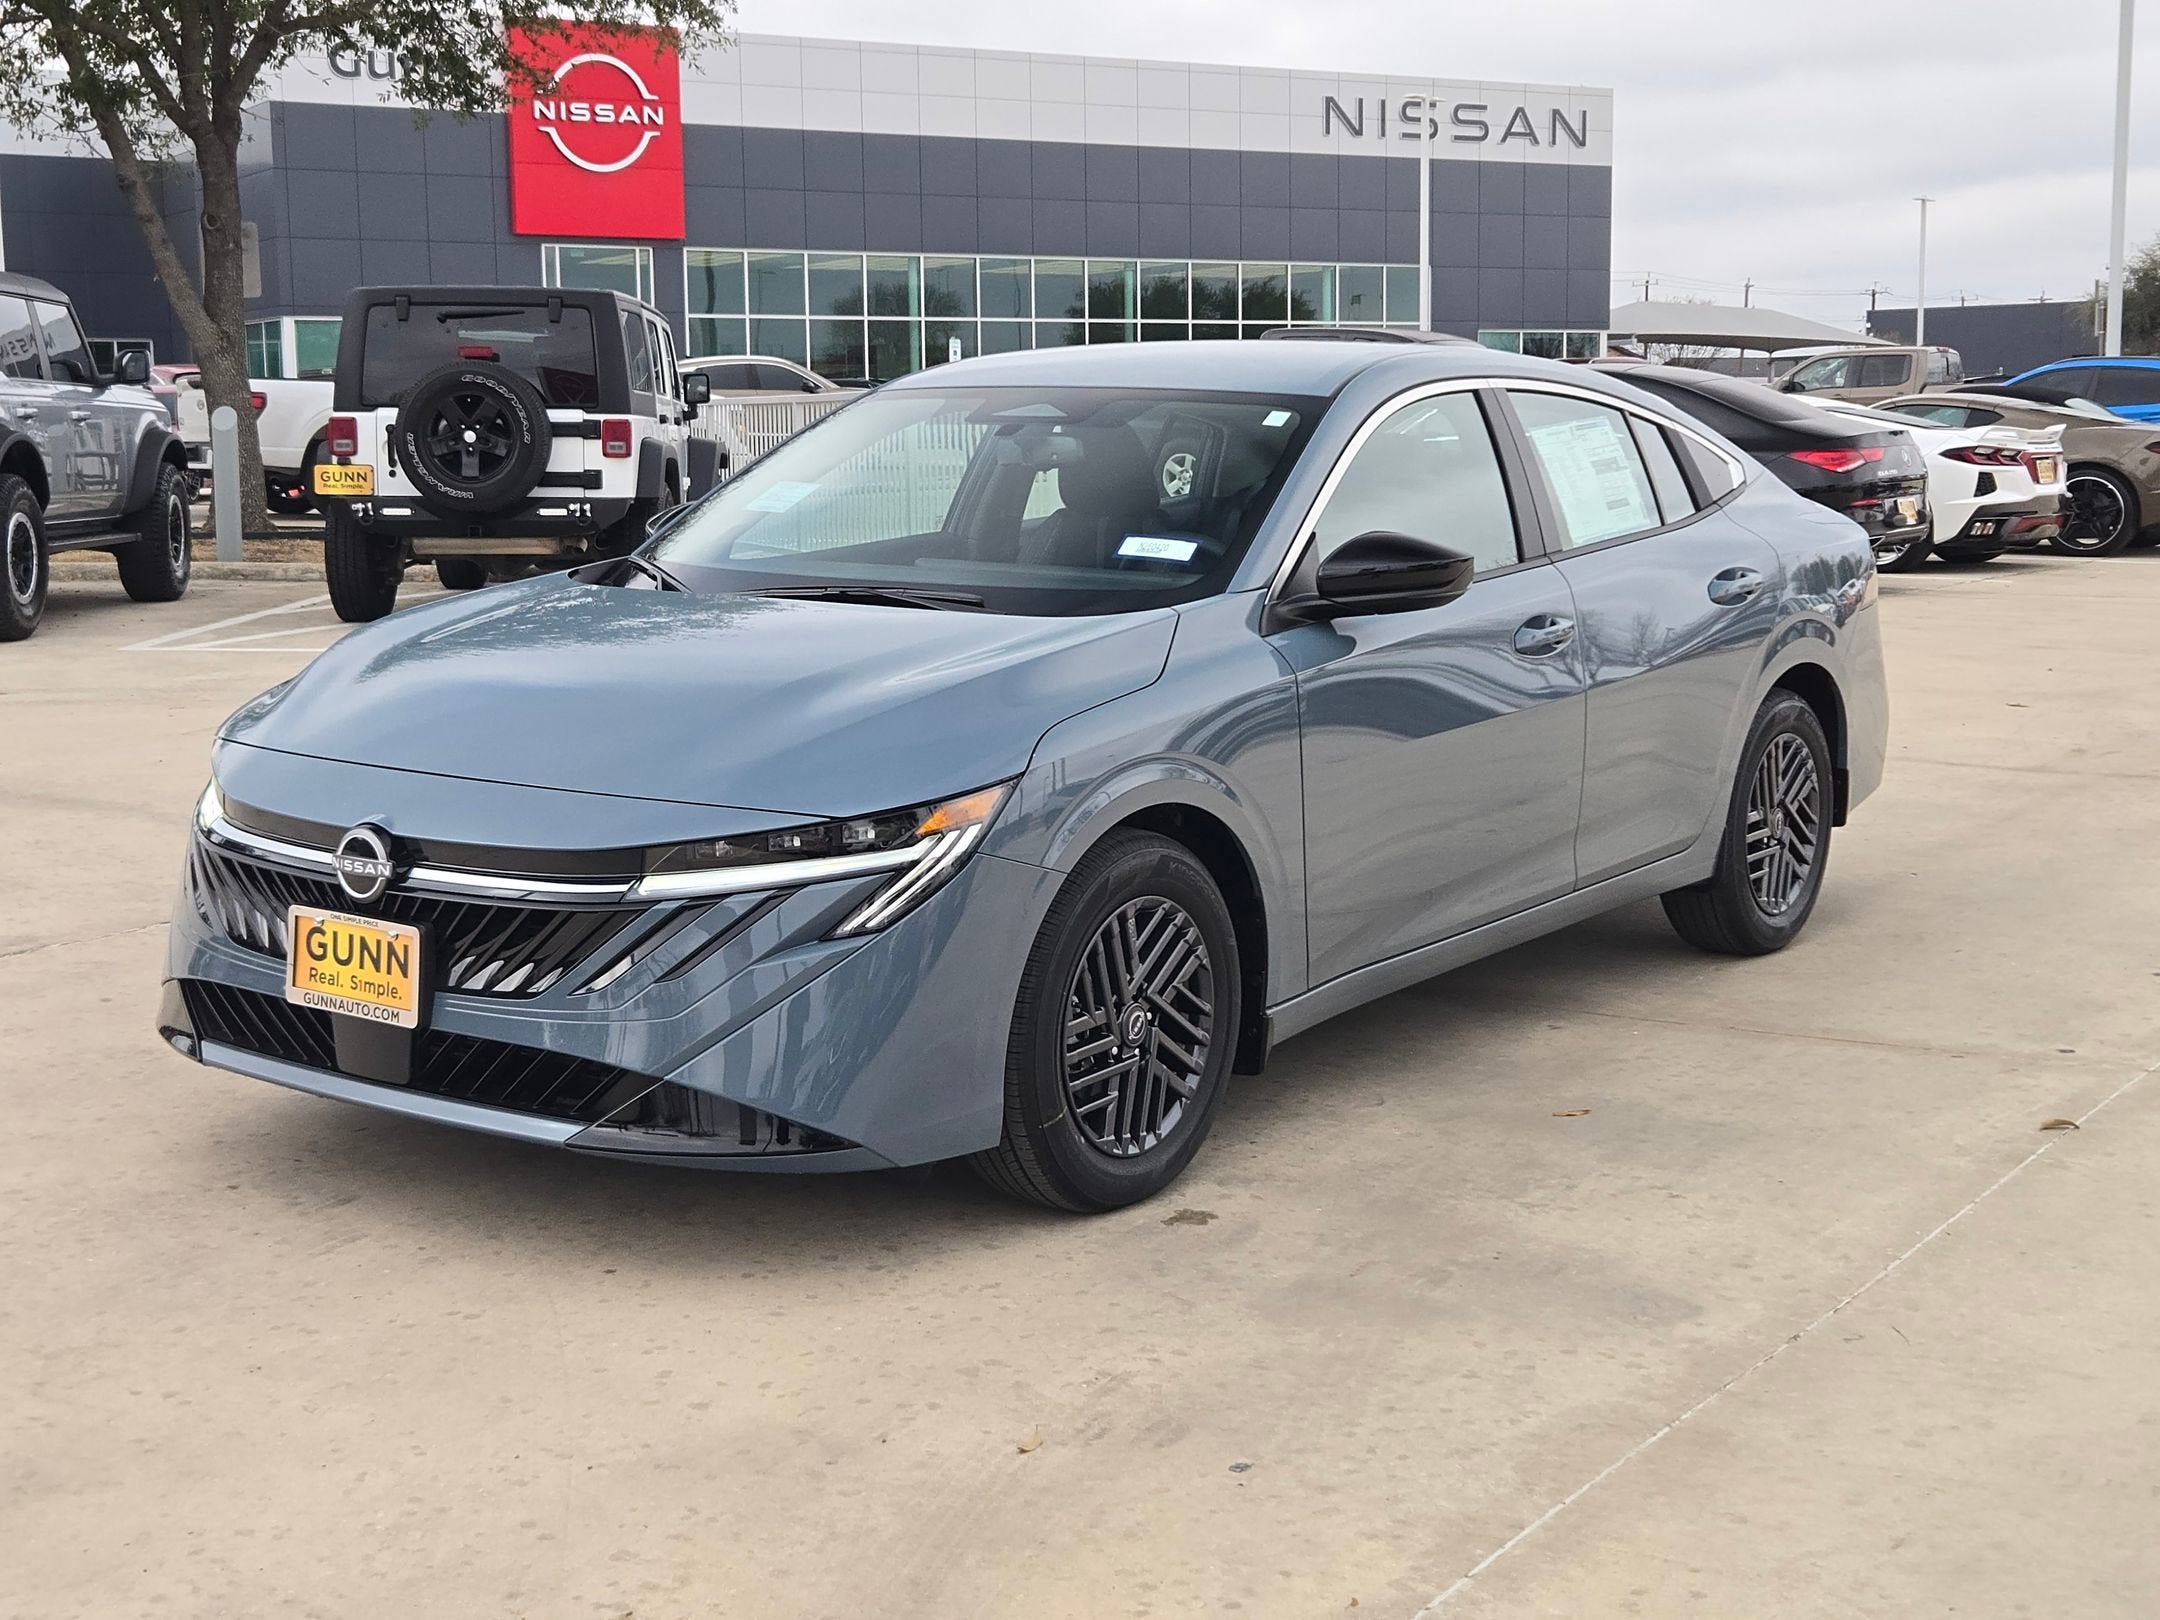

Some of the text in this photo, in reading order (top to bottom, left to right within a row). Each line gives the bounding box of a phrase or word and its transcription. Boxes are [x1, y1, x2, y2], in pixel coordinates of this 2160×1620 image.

[533, 100, 664, 126] NISSAN
[1323, 95, 1588, 148] NISSAN
[461, 374, 531, 444] GOODYEAR
[320, 471, 367, 482] GUNN
[406, 432, 474, 499] WRANGLER
[332, 856, 390, 876] NISSAN
[306, 926, 409, 979] GUNN
[308, 966, 344, 988] Real.
[303, 992, 400, 1023] GUNNAUTO.COM
